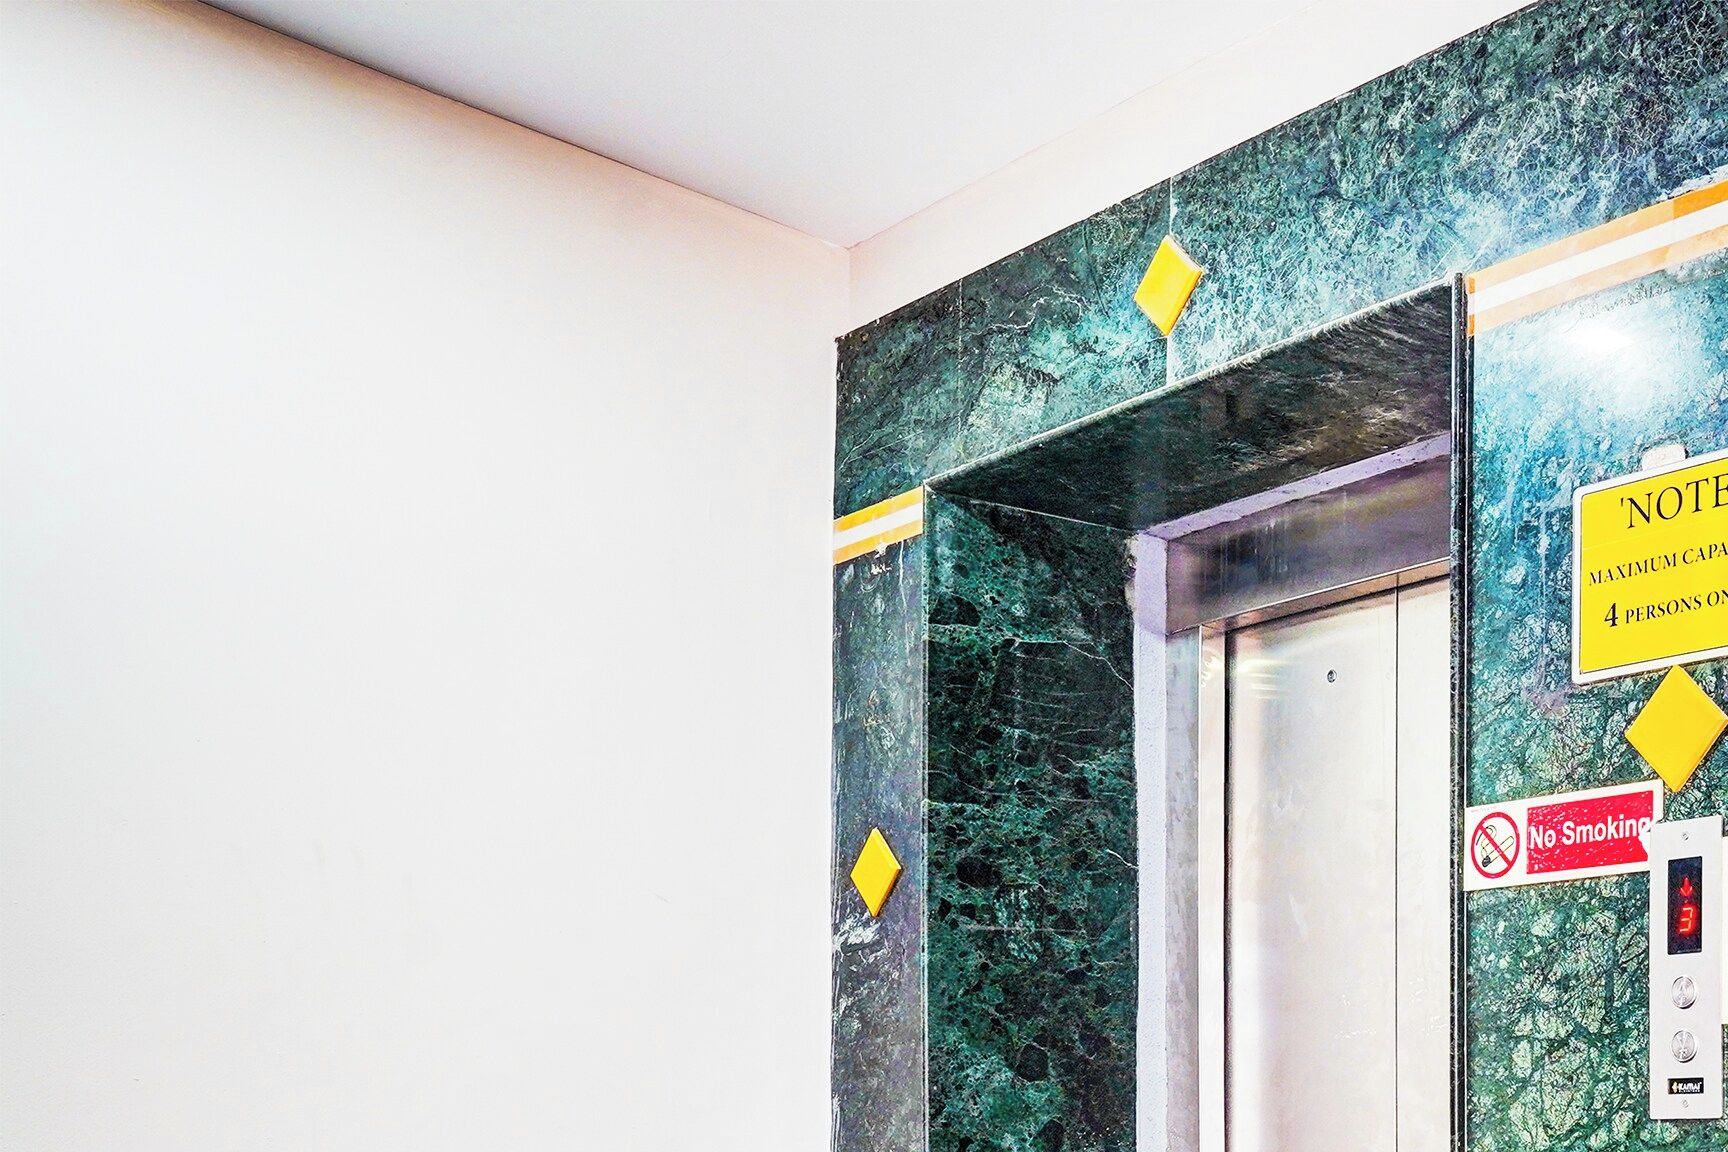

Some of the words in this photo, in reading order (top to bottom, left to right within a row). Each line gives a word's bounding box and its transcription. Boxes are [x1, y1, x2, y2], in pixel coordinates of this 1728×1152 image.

[1589, 553, 1677, 586] MAXIMUM
[1604, 602, 1619, 628] 4
[1625, 594, 1702, 624] PERSONS
[1529, 825, 1557, 849] No
[1680, 907, 1693, 932] 3
